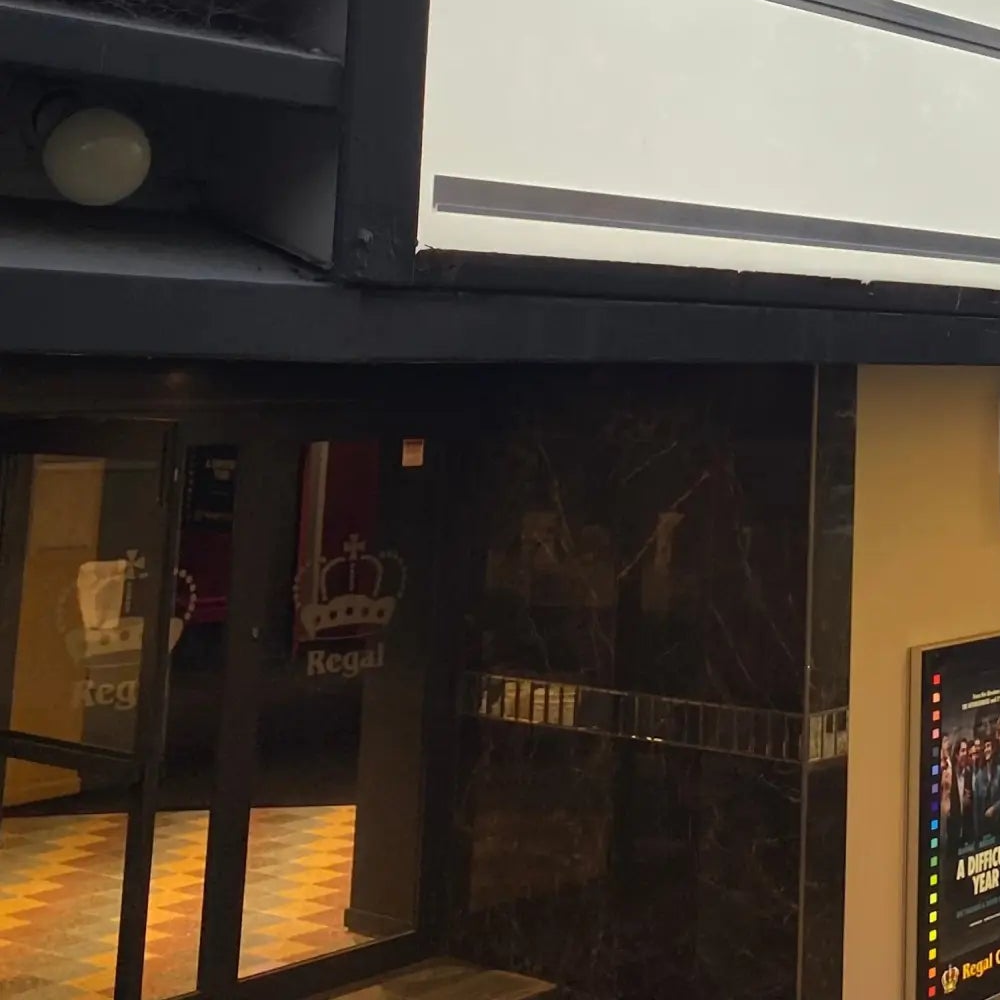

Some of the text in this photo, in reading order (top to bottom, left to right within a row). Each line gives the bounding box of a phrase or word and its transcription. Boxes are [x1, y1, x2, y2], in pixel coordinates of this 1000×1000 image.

[306, 643, 384, 679] Regal
[956, 858, 965, 880] A
[972, 868, 1000, 896] YEAR
[962, 953, 993, 980] Regal
